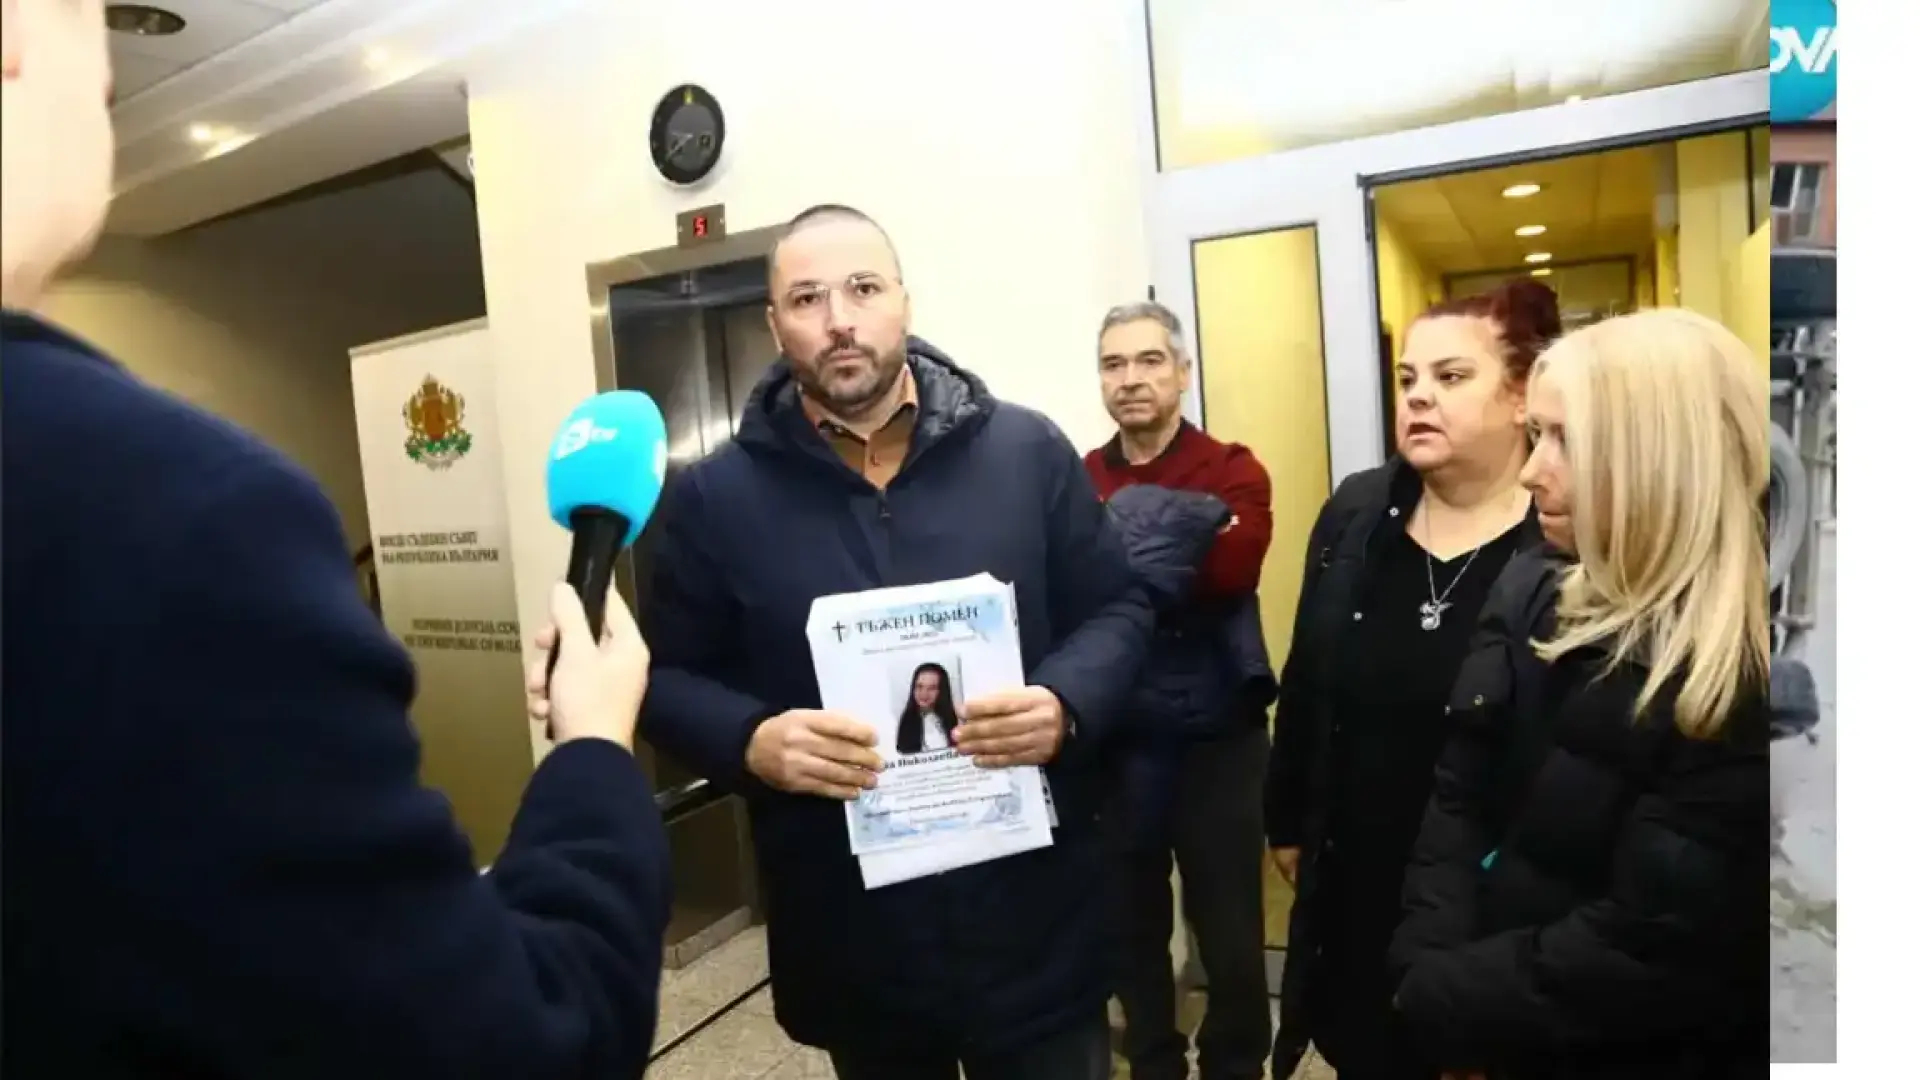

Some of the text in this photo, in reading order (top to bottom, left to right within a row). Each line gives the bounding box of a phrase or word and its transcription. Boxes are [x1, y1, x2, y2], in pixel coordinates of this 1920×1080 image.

[693, 216, 707, 237] 5
[856, 605, 978, 634] ТЪЖЕН ПОМЕН
